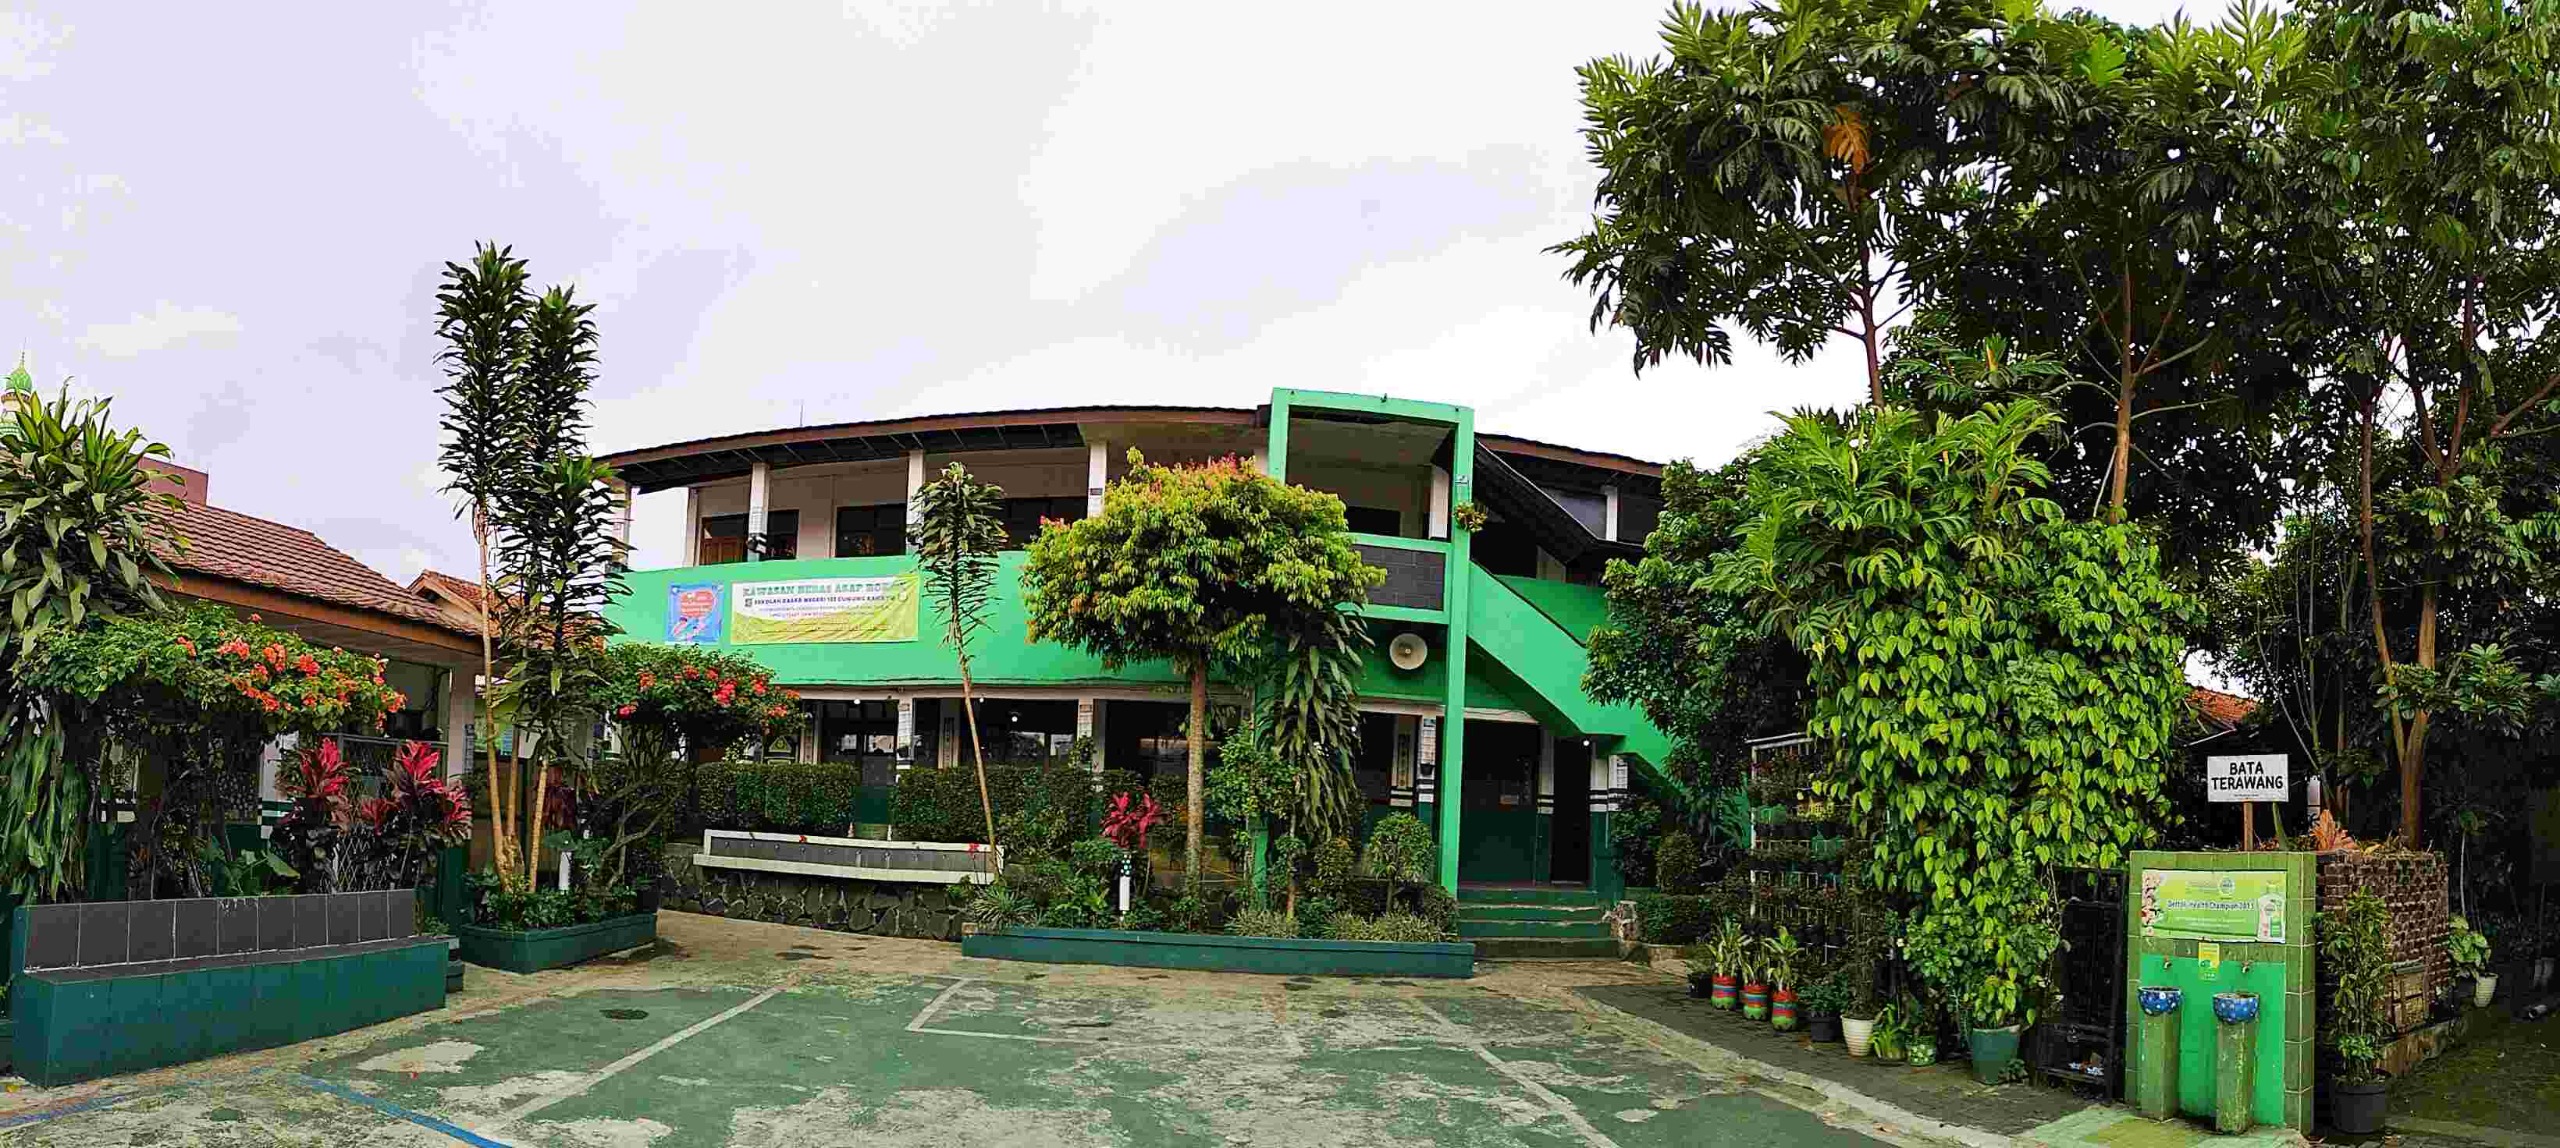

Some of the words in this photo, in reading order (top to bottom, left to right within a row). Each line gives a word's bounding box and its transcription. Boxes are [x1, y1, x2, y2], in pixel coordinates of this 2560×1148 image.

[742, 585, 794, 597] KAWASAN
[797, 584, 832, 595] BEBAS
[834, 583, 863, 593] ASAP
[2229, 761, 2264, 775] BATA
[2211, 776, 2284, 790] TERAWANG
[2209, 900, 2239, 911] Champion
